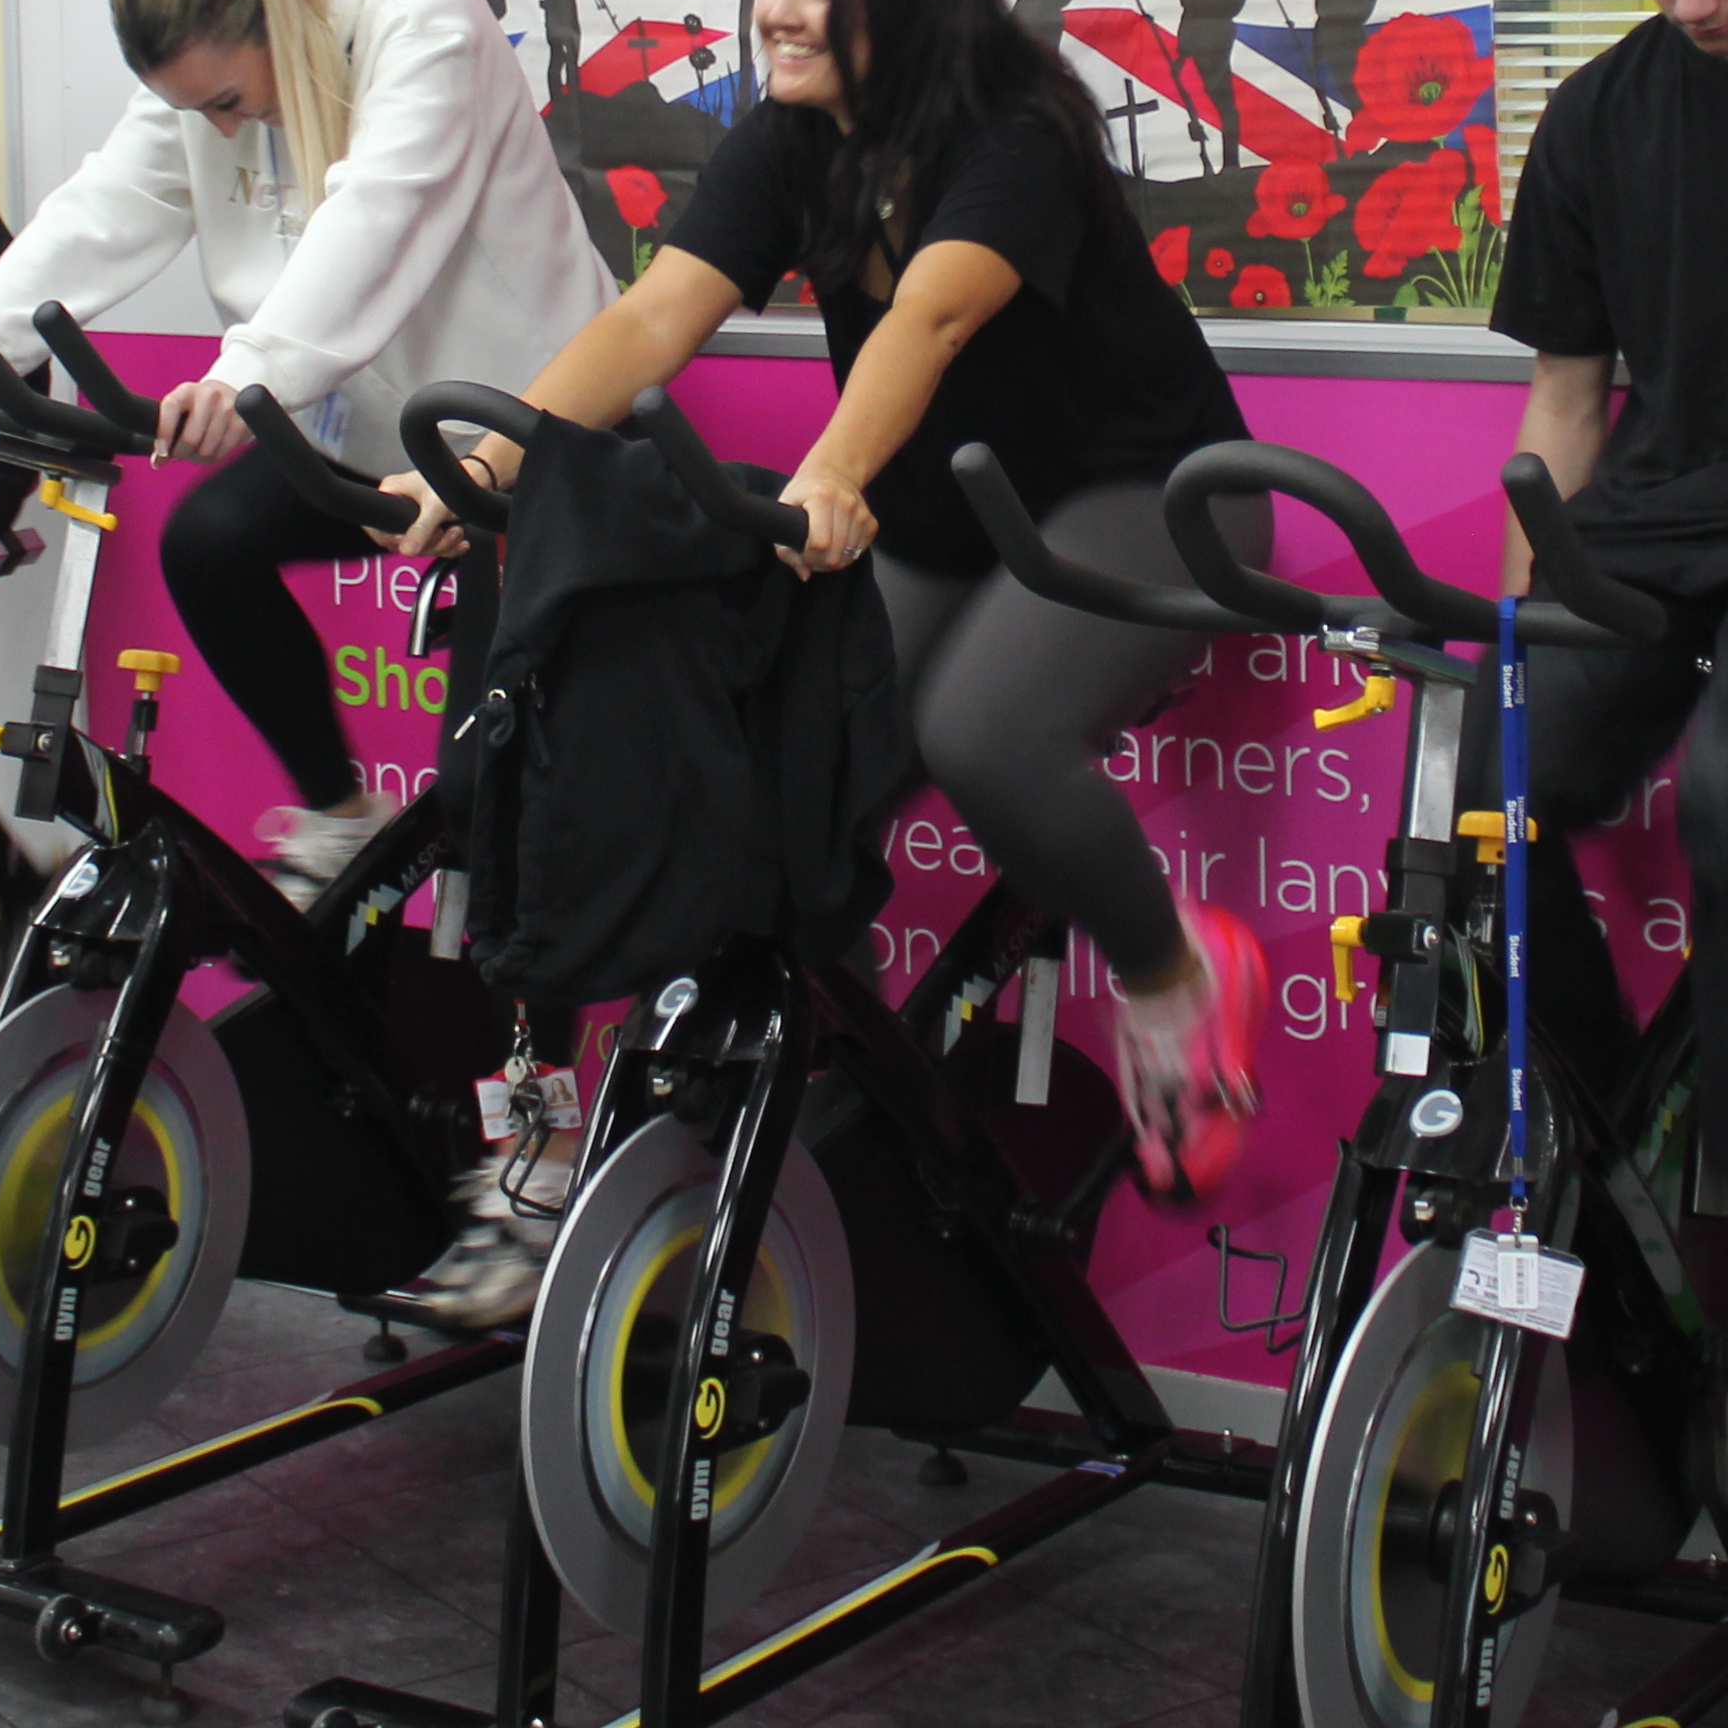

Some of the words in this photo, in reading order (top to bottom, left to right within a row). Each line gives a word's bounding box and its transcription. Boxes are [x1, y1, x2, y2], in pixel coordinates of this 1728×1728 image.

[1505, 798, 1517, 844] Student
[1508, 933, 1520, 979] Student
[1511, 1067, 1524, 1113] Student
[710, 1287, 737, 1358] gear
